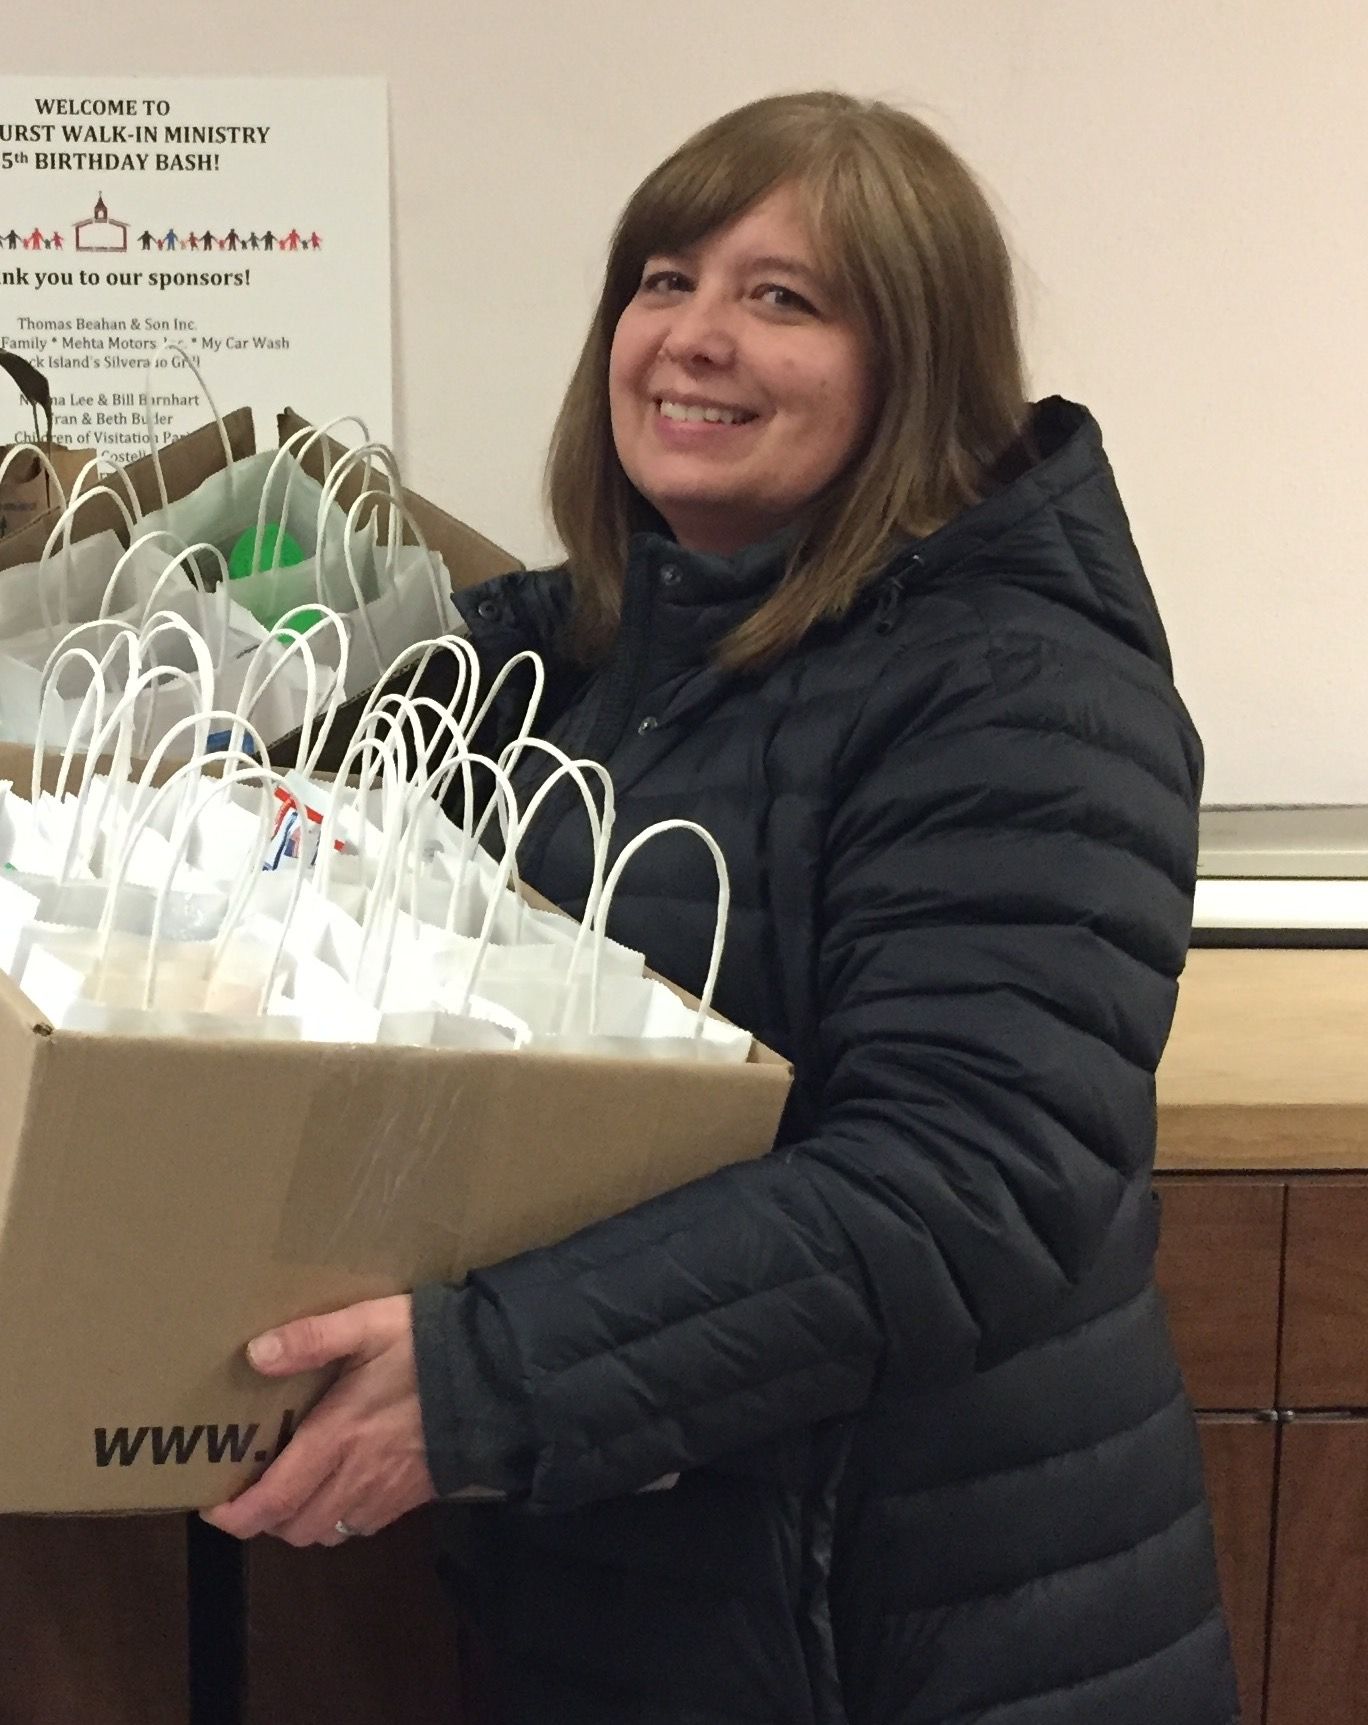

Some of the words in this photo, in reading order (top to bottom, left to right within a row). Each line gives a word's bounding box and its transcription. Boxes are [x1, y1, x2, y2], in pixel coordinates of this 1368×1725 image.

[34, 98, 138, 117] WELCOME
[142, 99, 171, 116] TO
[0, 125, 56, 143] URST
[61, 126, 158, 144] WALK-IN
[164, 127, 271, 145] MINISTRY
[1, 152, 29, 171] 5th
[35, 153, 149, 172] BIRTHDAY
[155, 154, 221, 172] BASH!
[0, 267, 29, 286] nk
[34, 272, 73, 291] you
[79, 270, 99, 287] to
[106, 273, 143, 287] our
[148, 269, 251, 292] sponsors!
[17, 317, 72, 331] Thomas
[76, 318, 127, 331] Beahan
[130, 318, 141, 331] &
[144, 318, 170, 331] Son
[1, 337, 47, 352] Family
[62, 337, 104, 350] Mehta
[108, 337, 157, 350] Motors
[202, 337, 222, 353] My
[226, 337, 248, 350] Car
[252, 337, 290, 350] Wash
[48, 356, 100, 369] Island's
[171, 355, 201, 369] Grl
[19, 393, 66, 407] Nma
[70, 393, 94, 407] Lee
[97, 394, 108, 407] &
[112, 393, 134, 407] Bill
[51, 413, 77, 426] ran
[81, 413, 92, 426] &
[96, 412, 128, 426] Beth
[14, 431, 73, 444] Chidren
[77, 431, 91, 444] of
[94, 431, 159, 445] Visitation
